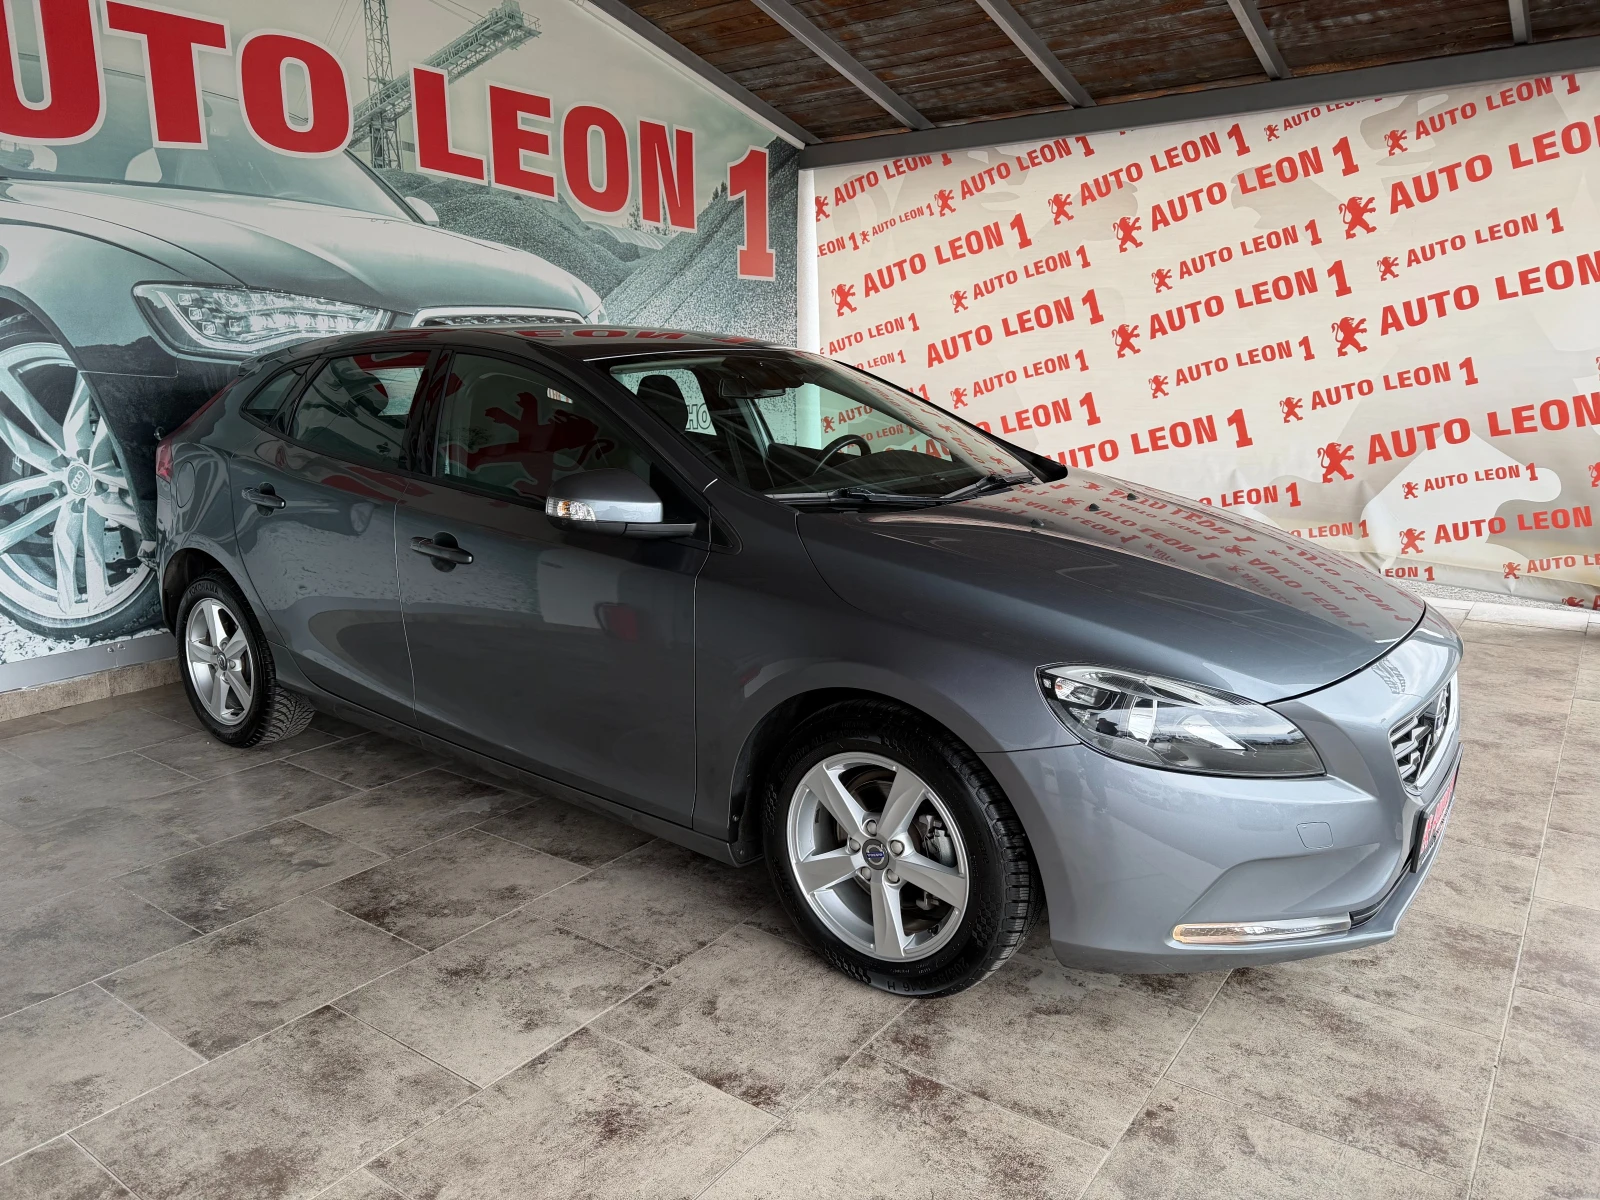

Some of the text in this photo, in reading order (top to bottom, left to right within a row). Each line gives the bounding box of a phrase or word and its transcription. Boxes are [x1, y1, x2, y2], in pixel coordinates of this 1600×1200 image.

[1284, 108, 1321, 130] AUTO
[1416, 102, 1477, 140] AUTO
[1486, 77, 1553, 111] LEON
[1562, 74, 1580, 94] 1
[414, 68, 695, 229] LEON
[730, 150, 774, 277] 1
[834, 171, 879, 206] AUTO
[960, 136, 1095, 200] AUTO LEON 1
[1080, 123, 1251, 206] AUTO LEON 1
[1152, 136, 1359, 232] AUTO LEON 1
[1390, 115, 1600, 214] AUTO LEO
[818, 232, 860, 256] EON 1
[872, 203, 934, 236] AUTO LEON 1
[1407, 208, 1564, 267] AUTO LEON 1
[864, 213, 1032, 298] AUTO LEON 1
[973, 245, 1091, 300] AUTO LEON 1
[1179, 219, 1322, 280] AUTO LEON 1
[1150, 260, 1352, 340] AUTO LEON 1
[1381, 285, 1480, 336] AUTO
[829, 313, 920, 355] AUTO LEON 1
[927, 289, 1104, 368] AUTO LEON 1
[868, 353, 895, 368] LEON
[898, 350, 906, 364] 1
[973, 349, 1089, 398] AUTO LEON 1
[1176, 336, 1315, 386] AUTO LEON 1
[1312, 357, 1478, 410] AUTO LEON 1
[919, 384, 930, 401] 1
[1000, 398, 1072, 434] LEON
[1079, 392, 1101, 426] 1
[876, 424, 904, 439] LEON
[1045, 408, 1253, 468] UTO LEON 1
[1368, 418, 1471, 465] AUTO
[1221, 482, 1301, 507] LEON 1
[1424, 463, 1538, 492] AUTO LEON 1
[1309, 522, 1353, 538] LEON
[1358, 520, 1368, 538] 1
[1435, 506, 1593, 544] AUTO LEON
[1425, 567, 1434, 581] 1
[1528, 556, 1576, 573] AUTO
